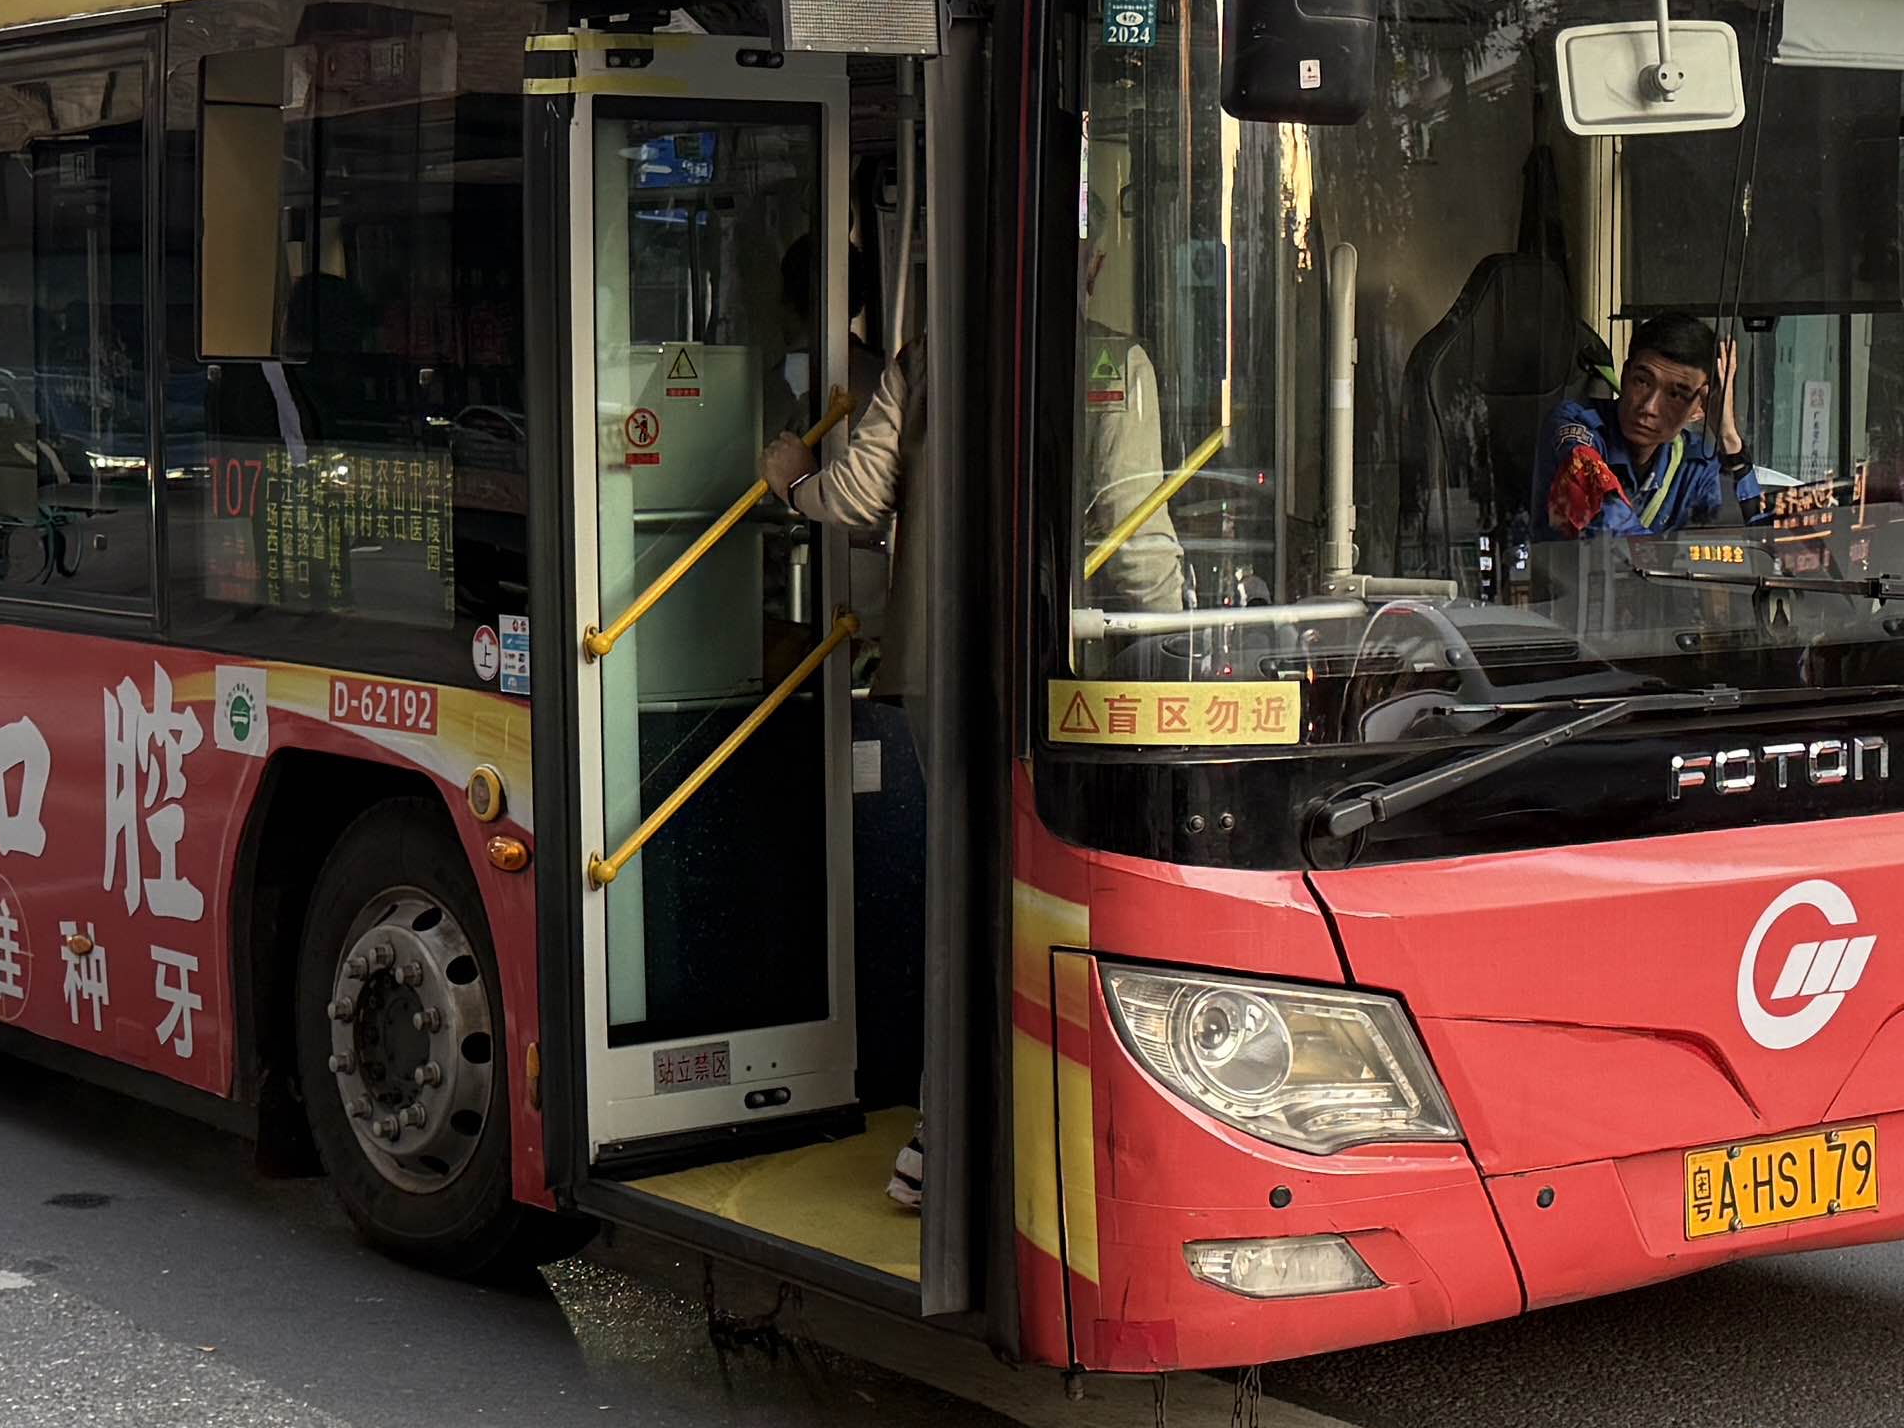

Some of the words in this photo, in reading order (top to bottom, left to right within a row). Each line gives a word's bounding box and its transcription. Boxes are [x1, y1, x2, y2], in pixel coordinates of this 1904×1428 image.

[1107, 26, 1151, 44] 2024
[208, 458, 263, 517] 107
[409, 459, 424, 542] 中山医
[335, 681, 433, 730] D-62192
[1104, 694, 1287, 735] 盲区勿近
[1669, 735, 1889, 802] FOTON
[658, 1051, 728, 1085] 站立禁区
